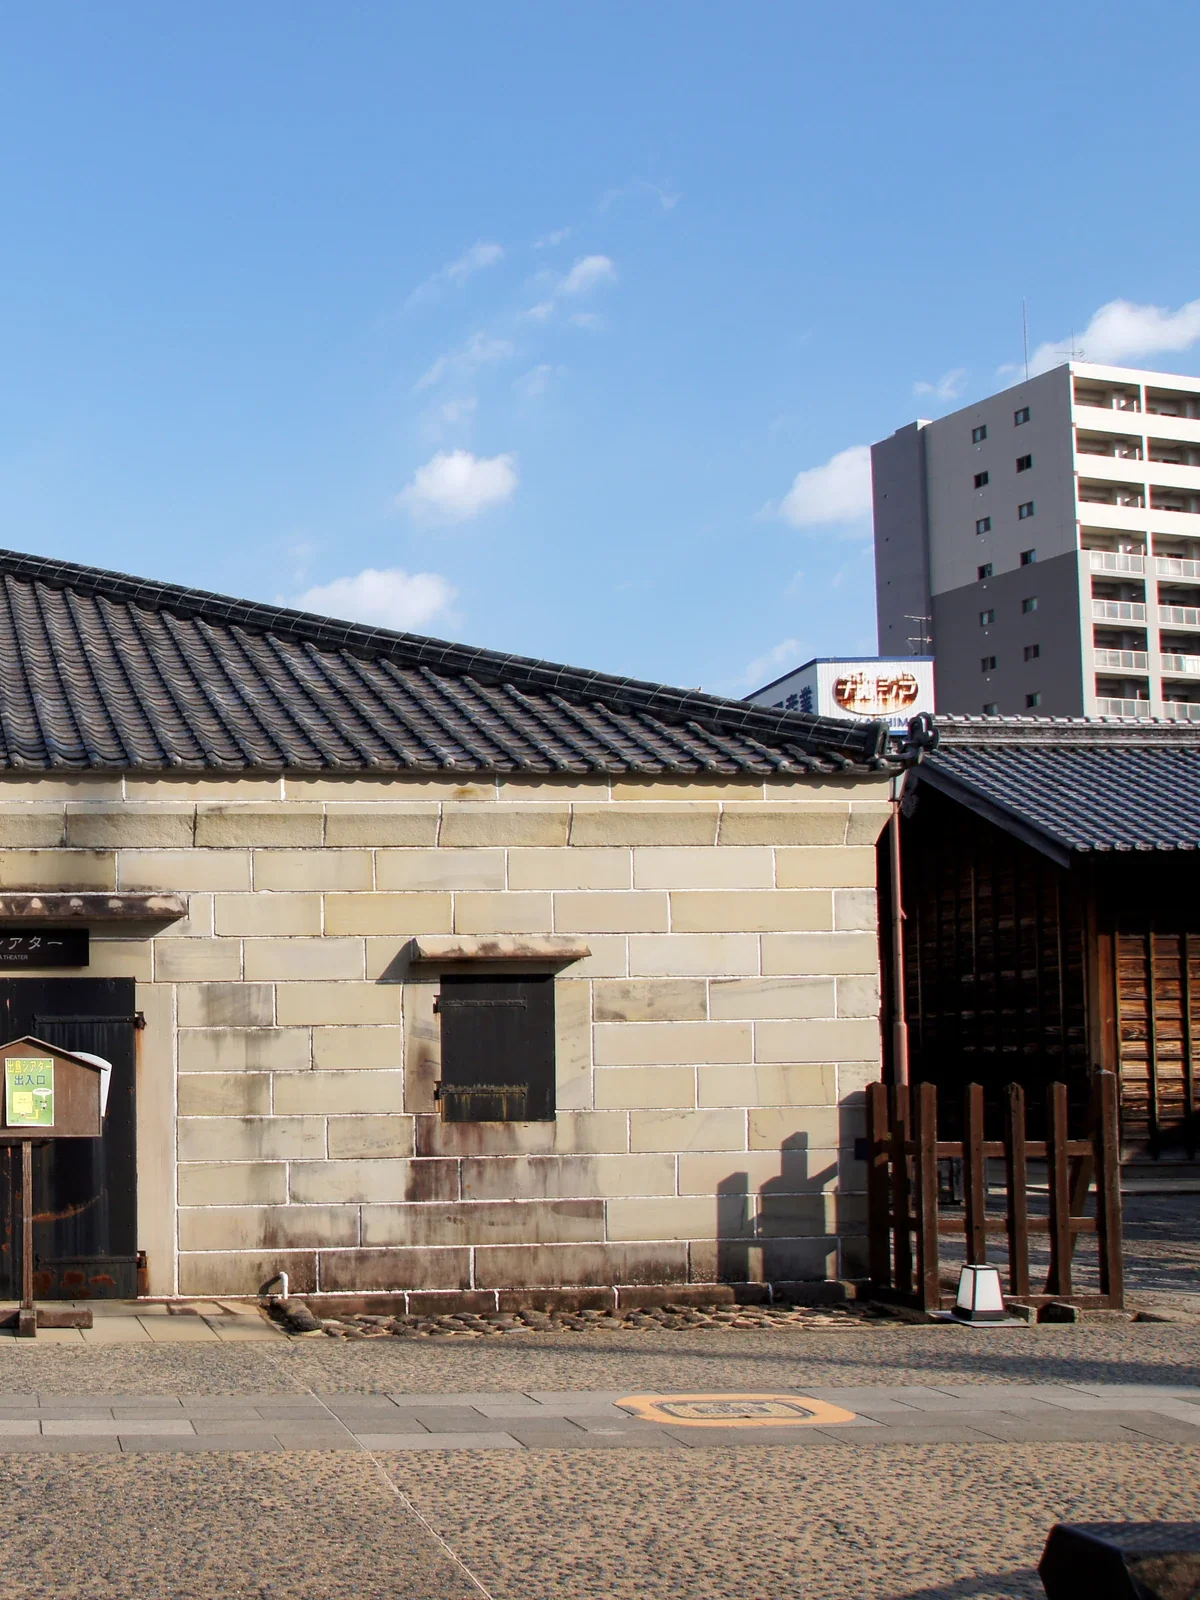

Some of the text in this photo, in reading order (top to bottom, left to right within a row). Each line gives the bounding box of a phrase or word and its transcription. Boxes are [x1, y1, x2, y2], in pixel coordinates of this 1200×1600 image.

[8, 1060, 51, 1073] 出島シアター
[15, 1075, 45, 1085] 出入口
